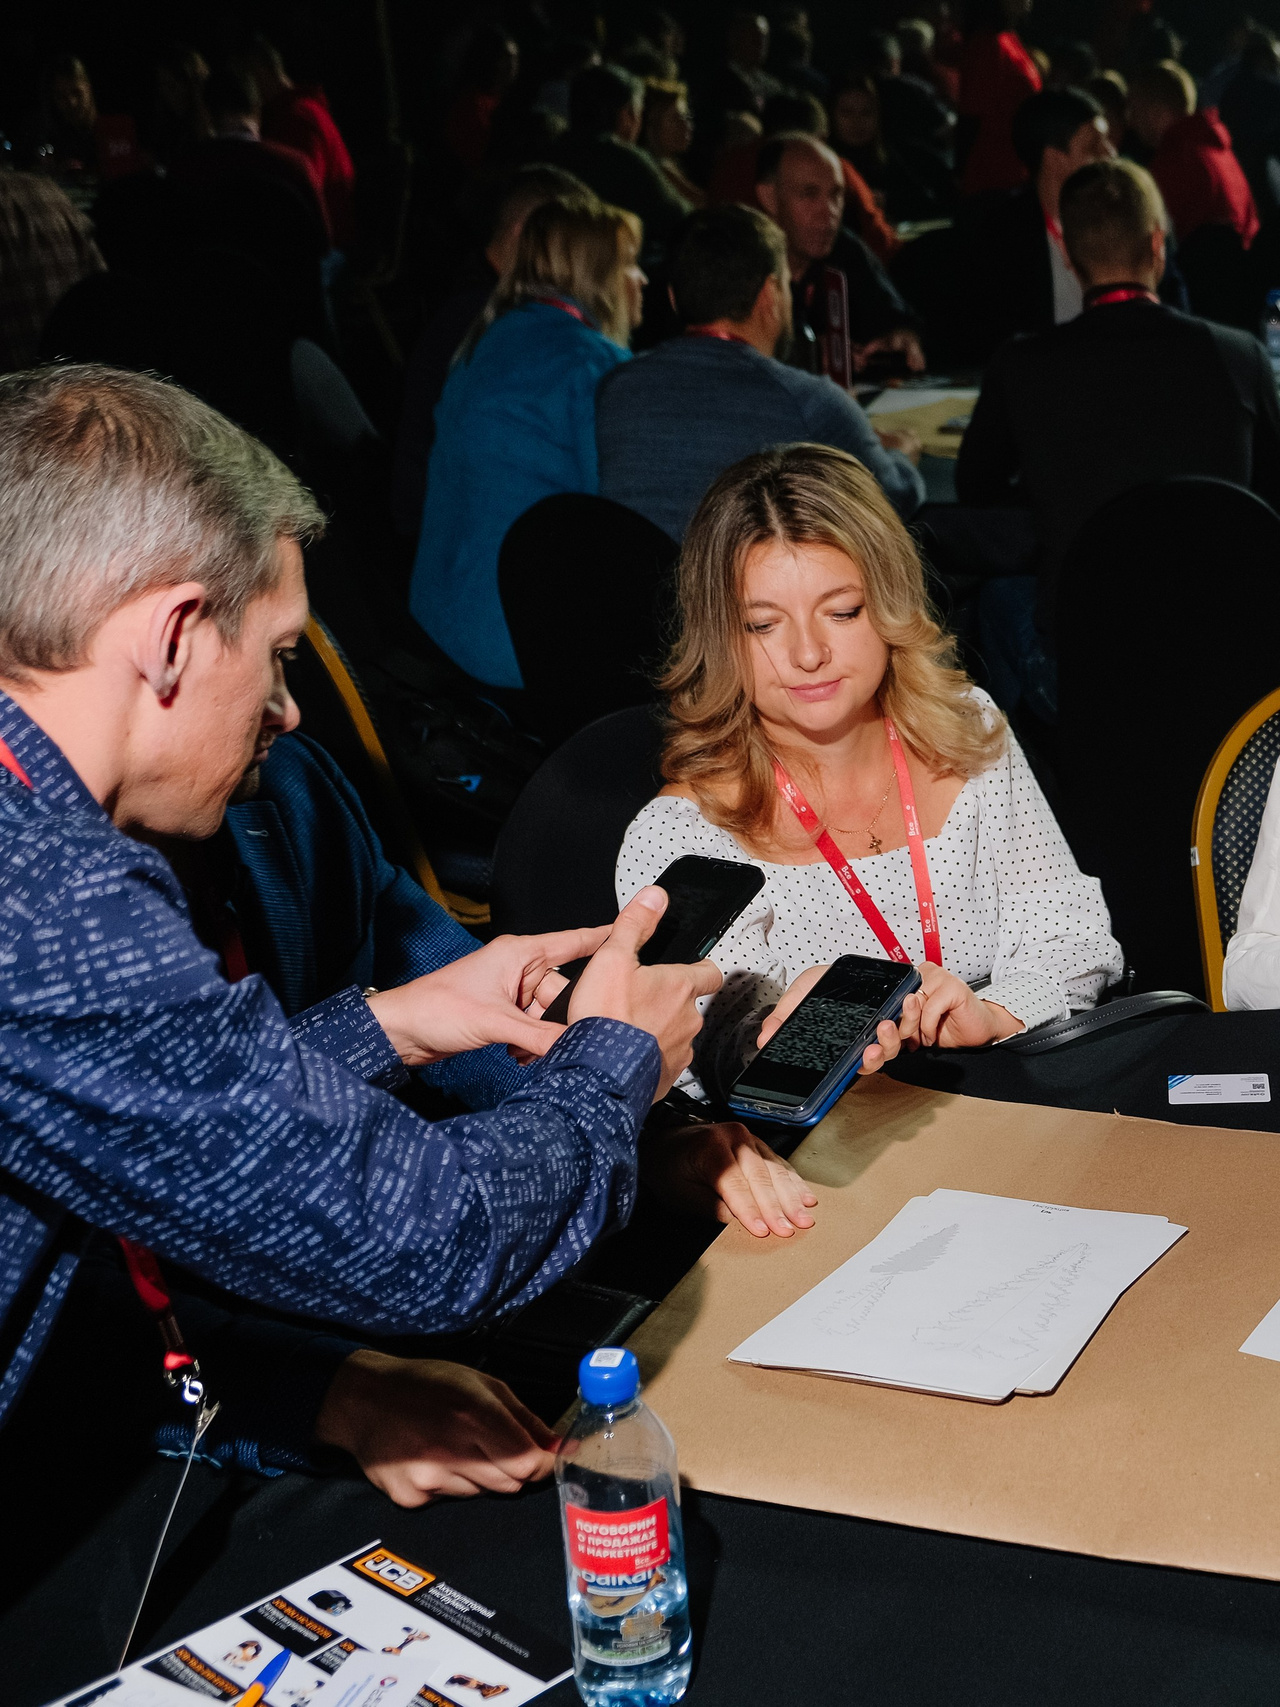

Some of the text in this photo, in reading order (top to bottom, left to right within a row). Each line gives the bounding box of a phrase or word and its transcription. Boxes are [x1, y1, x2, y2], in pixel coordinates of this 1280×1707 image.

[841, 865, 852, 880] Все
[924, 918, 932, 934] Все
[576, 1514, 657, 1537] ПОГОВОРИМ
[578, 1528, 657, 1548] О ПРОДАЖАХ
[578, 1540, 658, 1559] И МАРКЕТИНГЕ
[364, 1555, 425, 1590] JCB
